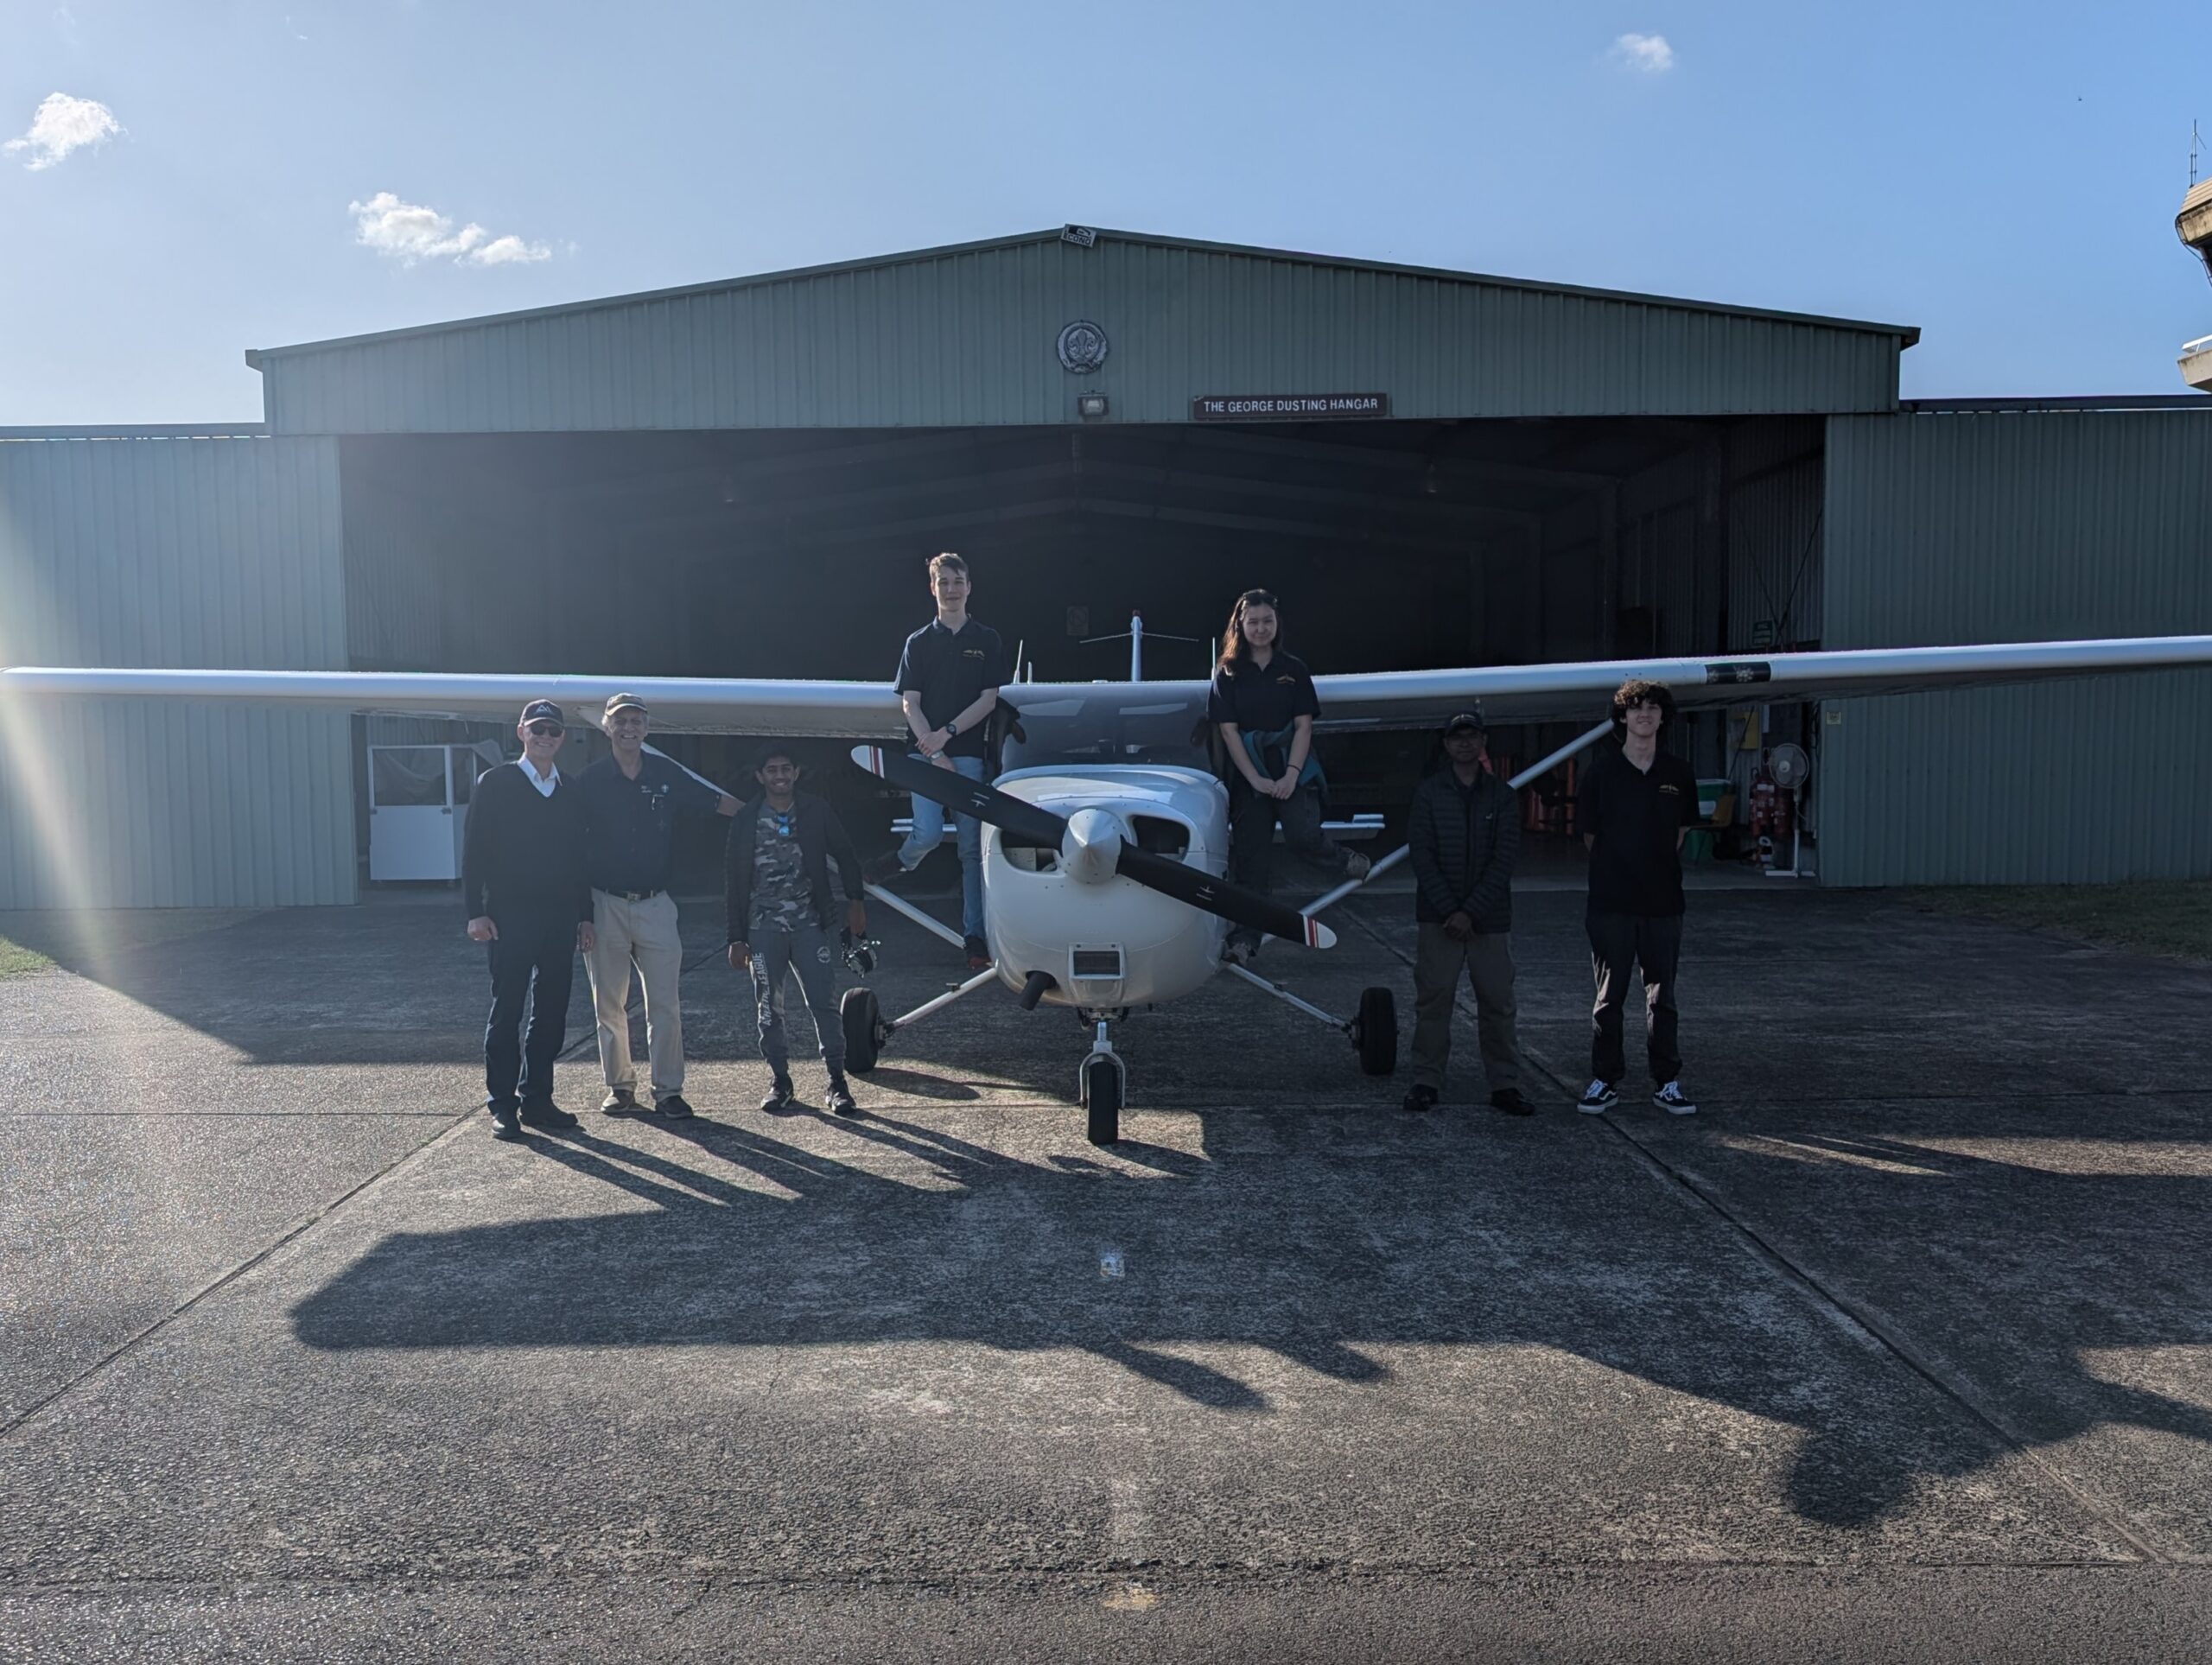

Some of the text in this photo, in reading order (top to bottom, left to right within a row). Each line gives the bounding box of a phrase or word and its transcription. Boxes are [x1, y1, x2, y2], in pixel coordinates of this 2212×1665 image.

[1204, 398, 1378, 412] THE GEORGE DUSTING HANGAR
[752, 952, 769, 986] LEAGUE
